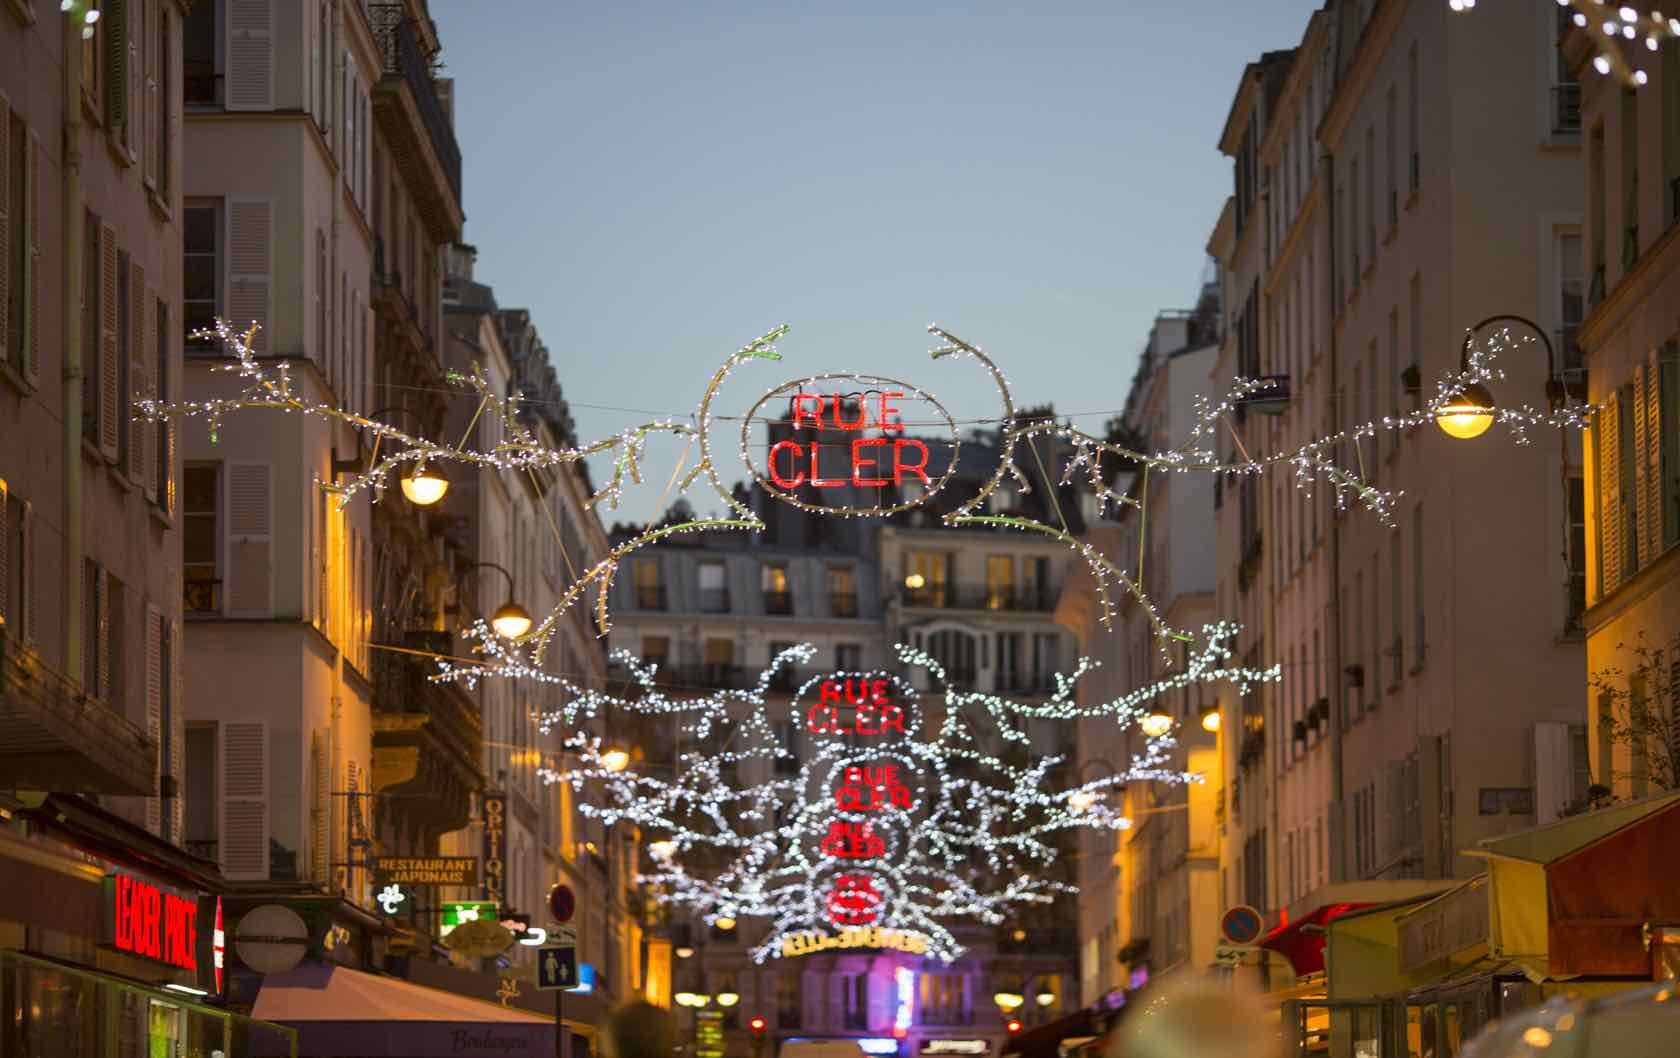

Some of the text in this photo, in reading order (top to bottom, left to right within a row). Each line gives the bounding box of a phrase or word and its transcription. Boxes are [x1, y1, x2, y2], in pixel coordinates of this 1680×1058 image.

[792, 391, 905, 431] RUE
[767, 438, 931, 489] CLER
[820, 678, 890, 704] RUE
[806, 703, 905, 735] CLER
[842, 764, 902, 785] RUE
[379, 859, 475, 871] RESTAURANT
[389, 871, 464, 882] JAPONAIS
[114, 872, 161, 961] LEADER
[163, 891, 198, 973] PRICE
